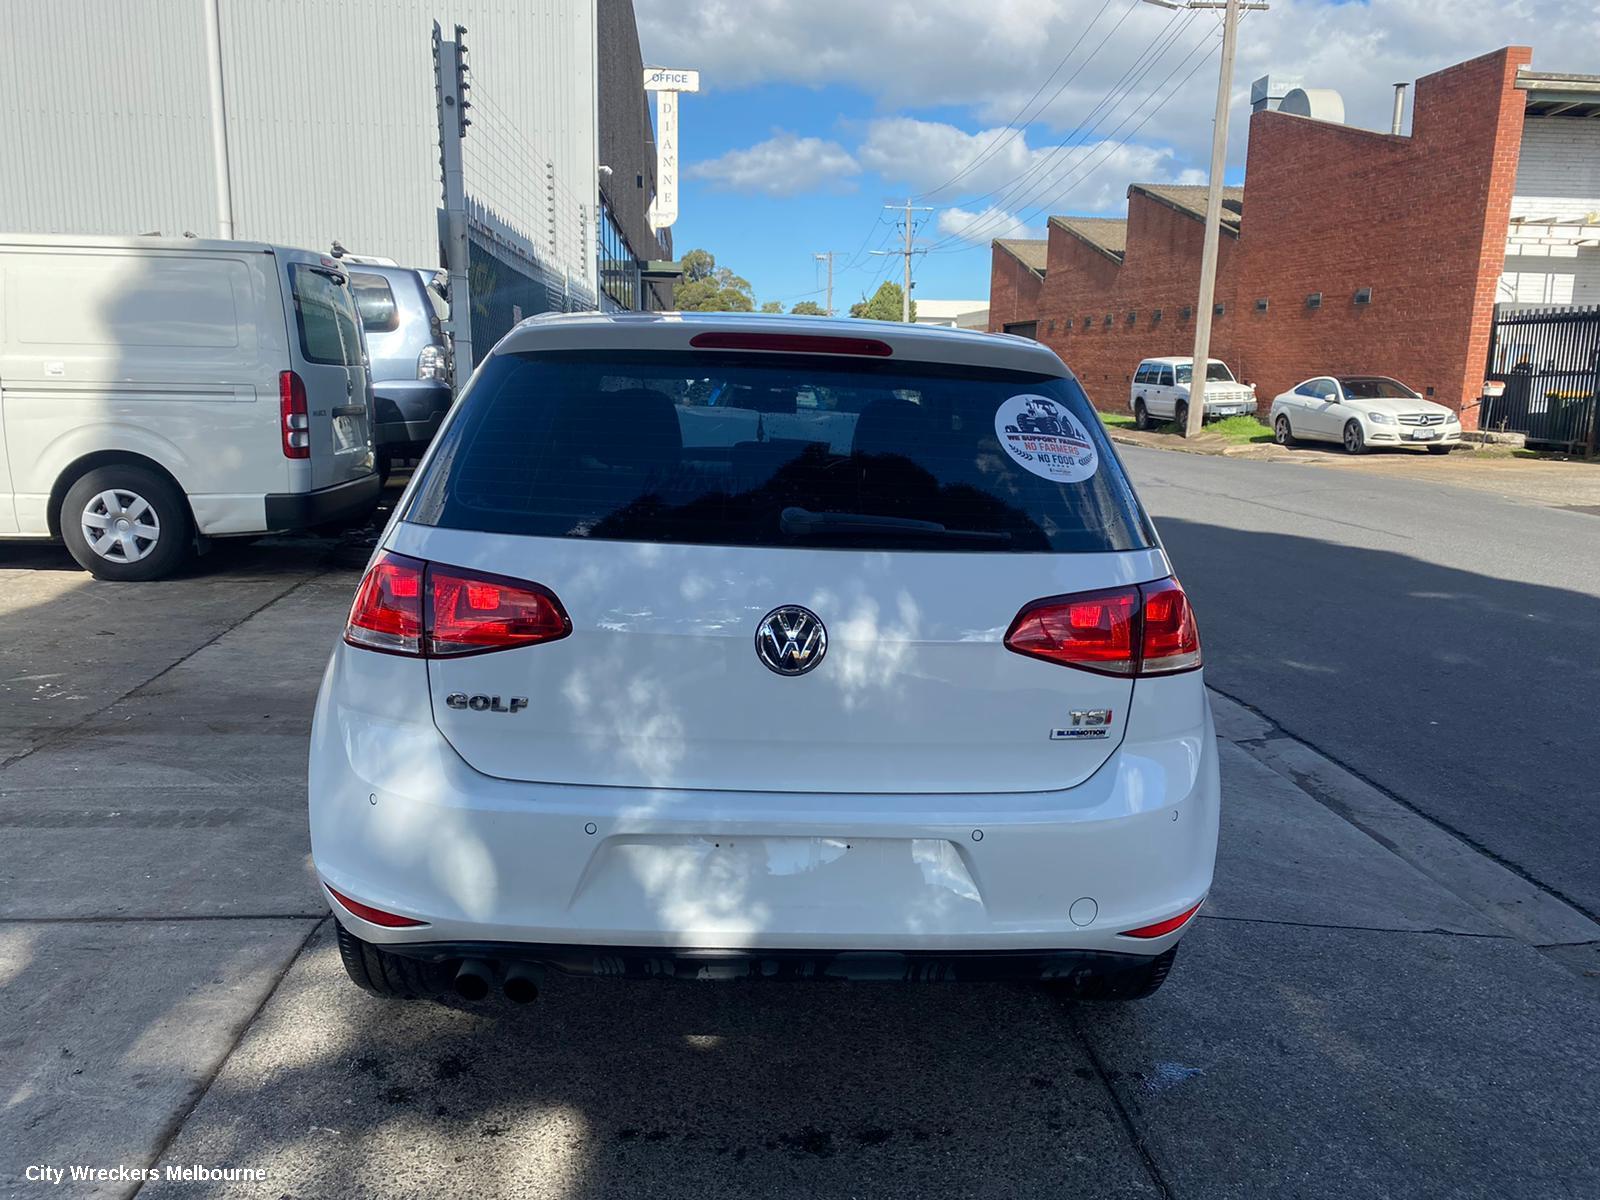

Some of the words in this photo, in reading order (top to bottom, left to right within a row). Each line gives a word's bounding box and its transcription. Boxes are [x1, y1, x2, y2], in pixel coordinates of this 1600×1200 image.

[651, 73, 689, 84] OFFICE
[662, 103, 673, 204] DIANNE
[1024, 441, 1038, 451] NO
[1040, 442, 1080, 456] FARMERS
[1037, 453, 1051, 463] NO
[1052, 455, 1075, 466] FOOD
[446, 692, 529, 714] GOLF
[1056, 729, 1107, 737] BLUEMOTION
